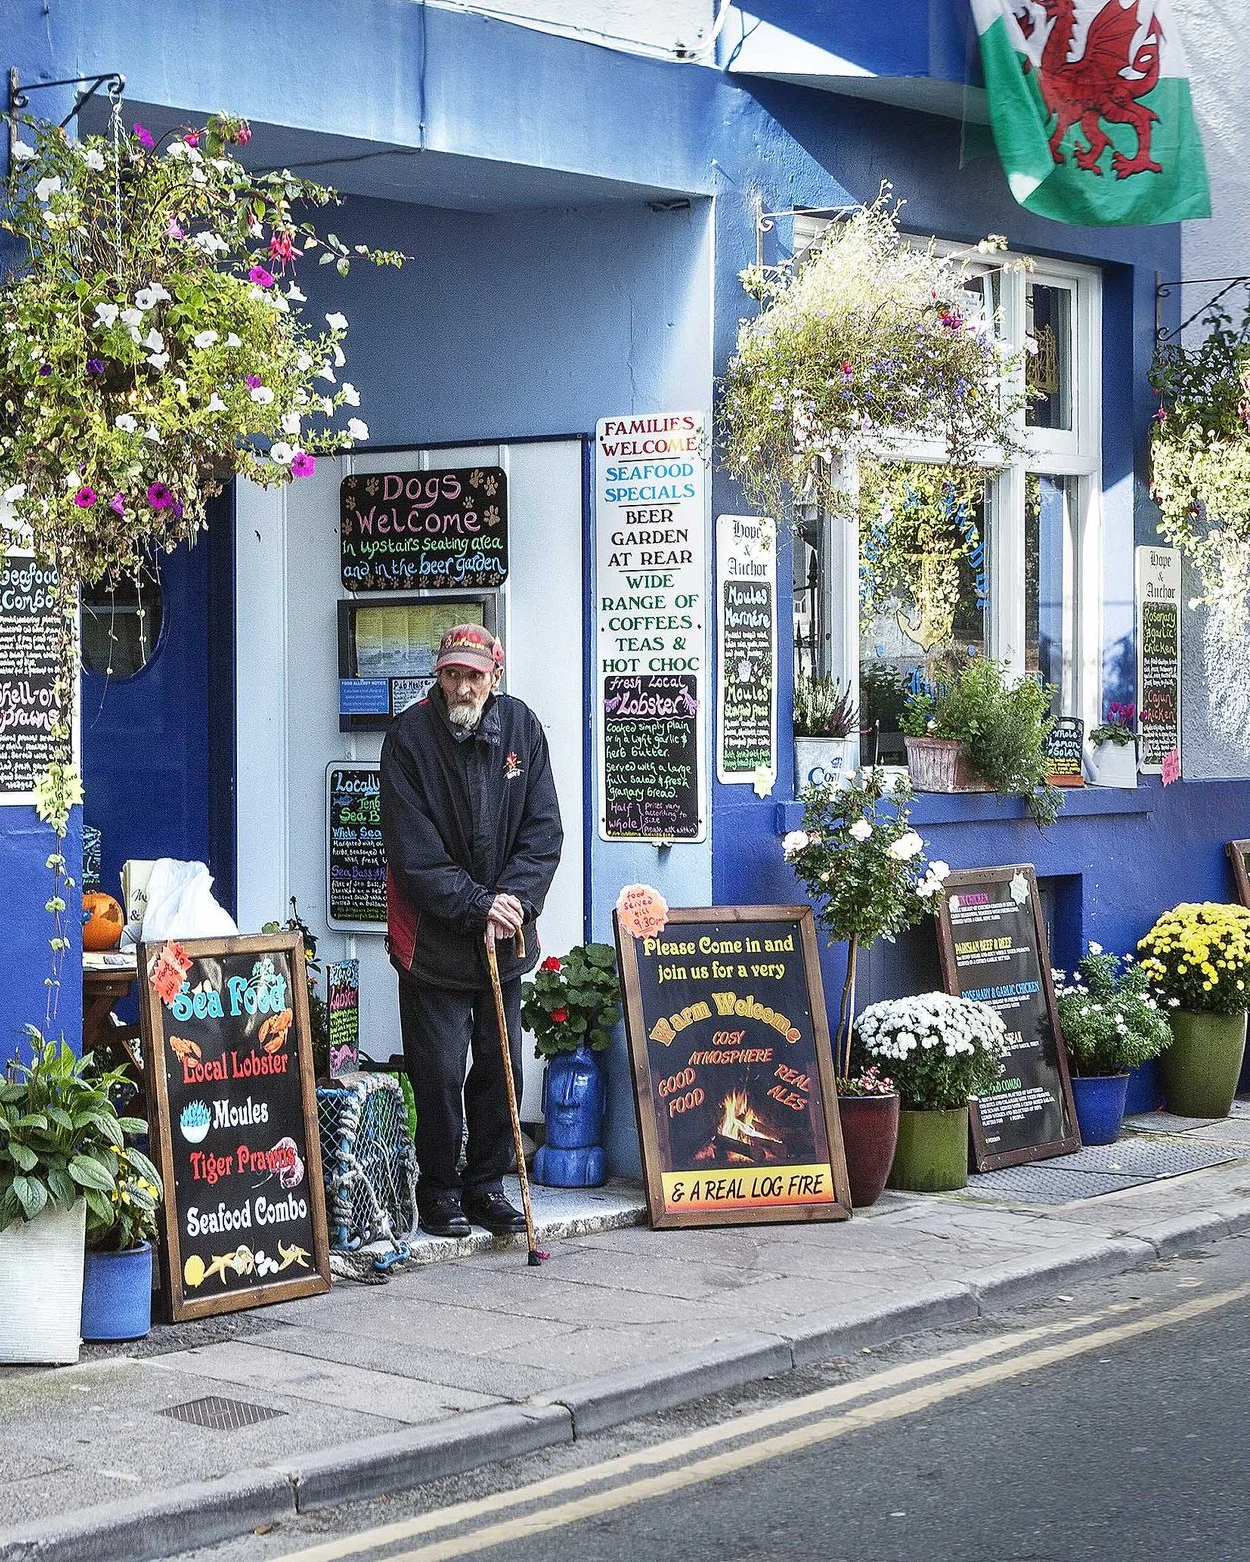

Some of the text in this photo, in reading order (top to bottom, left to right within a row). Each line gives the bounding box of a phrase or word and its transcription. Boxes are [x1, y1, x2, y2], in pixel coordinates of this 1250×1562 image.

[604, 416, 695, 436] FAMILIES
[602, 438, 698, 457] WELCOME
[605, 463, 694, 482] SEAFOOD
[383, 474, 462, 509] Dogs
[604, 484, 695, 502] SPECIALS
[355, 505, 481, 535] Welcome
[626, 509, 674, 524] BEER
[611, 529, 688, 546] GARDEN
[733, 520, 760, 539] Hope
[360, 538, 420, 560] upstairs
[471, 535, 503, 550] area
[343, 551, 507, 581] and in the beer garden
[608, 550, 693, 567] AT REAR
[728, 557, 768, 577] Anchor
[1150, 551, 1172, 569] Hope
[626, 574, 674, 589] WIDE
[1146, 582, 1176, 600] Anchor
[2, 586, 54, 614] Combo
[602, 594, 699, 611] RANGE OF
[728, 585, 768, 607] Moules
[608, 616, 693, 631] COFFEES
[1144, 607, 1176, 628] Rosemary
[615, 637, 686, 652] TEAS &
[602, 657, 699, 673] HOT CHOC
[616, 691, 683, 715] Lobster
[727, 685, 768, 703] Moules
[654, 734, 680, 748] garlic
[356, 795, 381, 810] Tenb
[339, 807, 367, 821] Sea
[360, 827, 382, 837] Sea
[643, 934, 794, 957] Please Come in and
[658, 961, 786, 984] join us for a very
[172, 972, 288, 1021] Sea Food
[1016, 980, 1040, 994] CHICKEN
[649, 991, 801, 1047] Warm Welcome
[712, 1030, 746, 1046] COSY
[183, 1048, 289, 1084] Local Lobster
[688, 1048, 774, 1066] ATMOSPHERE
[658, 1067, 697, 1098] GOOD
[774, 1063, 811, 1093] REAL
[668, 1087, 706, 1118] FOOD
[766, 1084, 808, 1112] ALES
[213, 1096, 269, 1130] Moules
[190, 1145, 297, 1185] Tiger Prawns
[671, 1173, 824, 1203] & A REAL LOG FIRE
[186, 1192, 308, 1237] Seafood Combo
